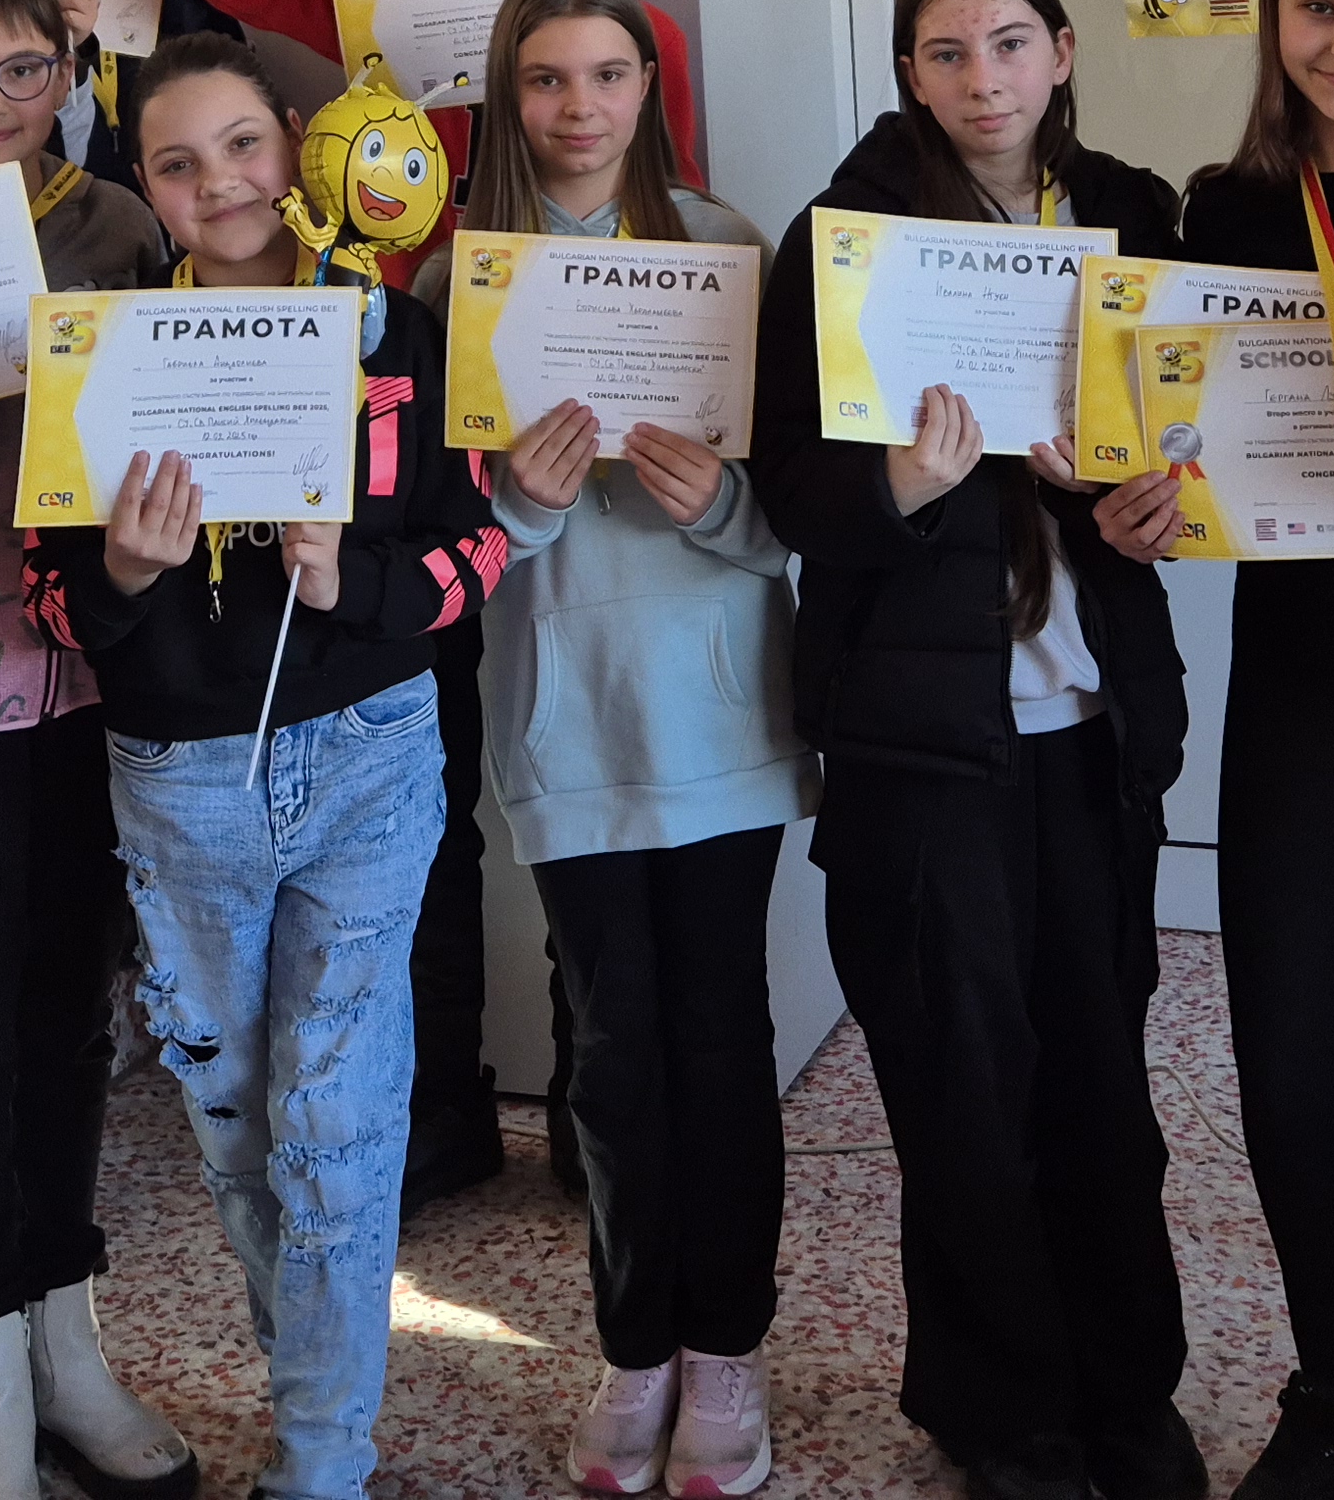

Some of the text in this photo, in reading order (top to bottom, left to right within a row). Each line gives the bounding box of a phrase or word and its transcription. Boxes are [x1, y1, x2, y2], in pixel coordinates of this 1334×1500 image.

[904, 234, 1095, 253] BULGARIAN NATIONAL ENGLISH SPELLING BEE
[549, 252, 596, 261] BULGARIAN
[599, 255, 640, 263] NATIONAL
[642, 257, 677, 266] ENGLISH
[679, 259, 719, 268] SPELLING
[920, 248, 1078, 277] ГРАМОТА
[564, 265, 722, 292] ГРАМОТА
[1185, 279, 1236, 291] BULGARIAN
[1239, 284, 1284, 295] NATIONAL
[136, 307, 186, 316] BULGARIAN
[190, 306, 234, 314] NATIONAL
[276, 305, 318, 313] SPELLING
[1201, 293, 1326, 319] ГРАМО
[153, 318, 320, 341] ГРАМОТА
[1018, 339, 1052, 347] SPELLING
[1054, 340, 1069, 348] BEE
[1238, 338, 1290, 347] BULGARIAN
[1293, 337, 1332, 346] NATIONA
[50, 345, 71, 354] BEE
[544, 346, 585, 354] BULGARIAN
[588, 348, 623, 356] NATIONAL
[626, 350, 657, 358] ENGLISH
[659, 352, 693, 360] SPELLING
[587, 392, 679, 402] CONGRATULATIONS!
[1265, 389, 1310, 402] Гергана
[132, 408, 175, 417] BULGARIAN
[178, 406, 216, 414] NATIONAL
[219, 405, 251, 413] ENGLISH
[1267, 410, 1290, 418] Второ
